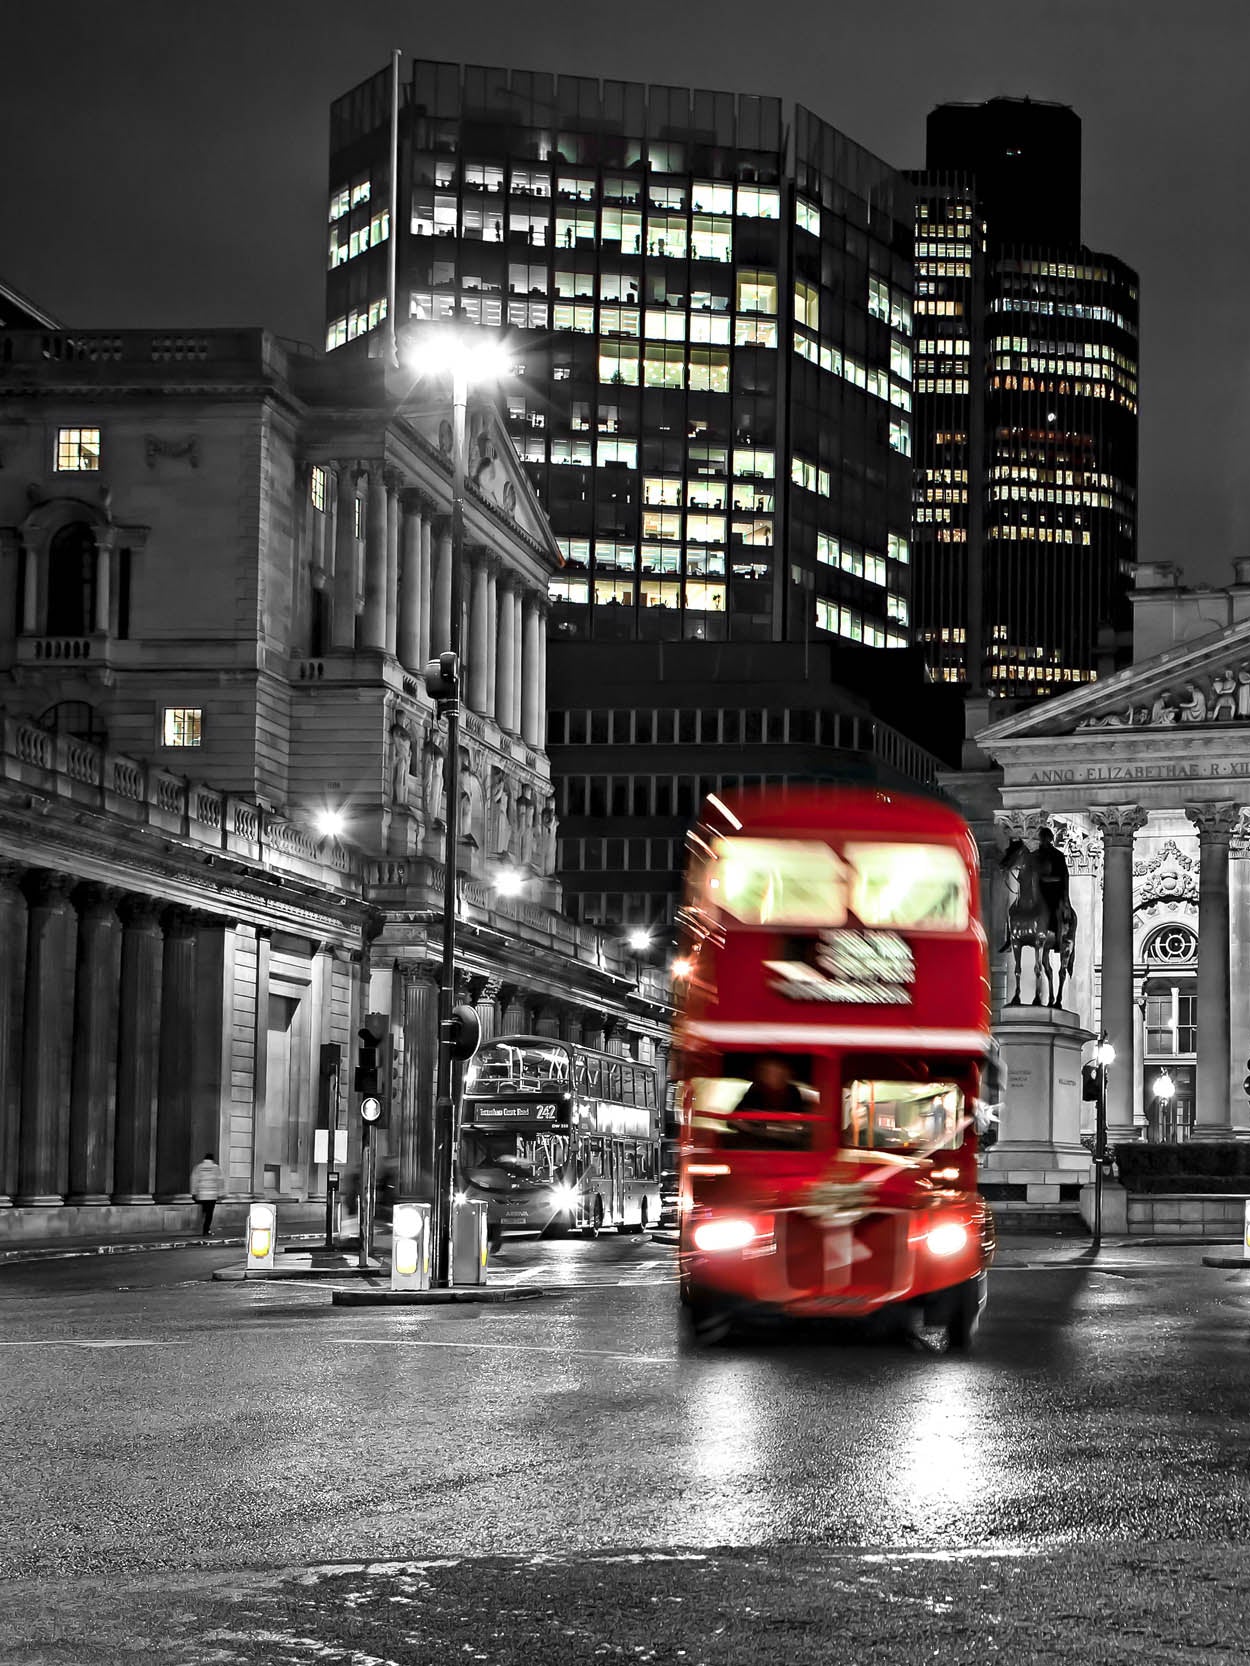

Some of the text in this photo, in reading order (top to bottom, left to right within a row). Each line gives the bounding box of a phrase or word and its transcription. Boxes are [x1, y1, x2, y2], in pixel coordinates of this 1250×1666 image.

[1029, 769, 1075, 784] ANNO
[1086, 763, 1200, 781] ELIZABETHAE
[1210, 763, 1220, 776] R
[536, 1104, 556, 1119] 242
